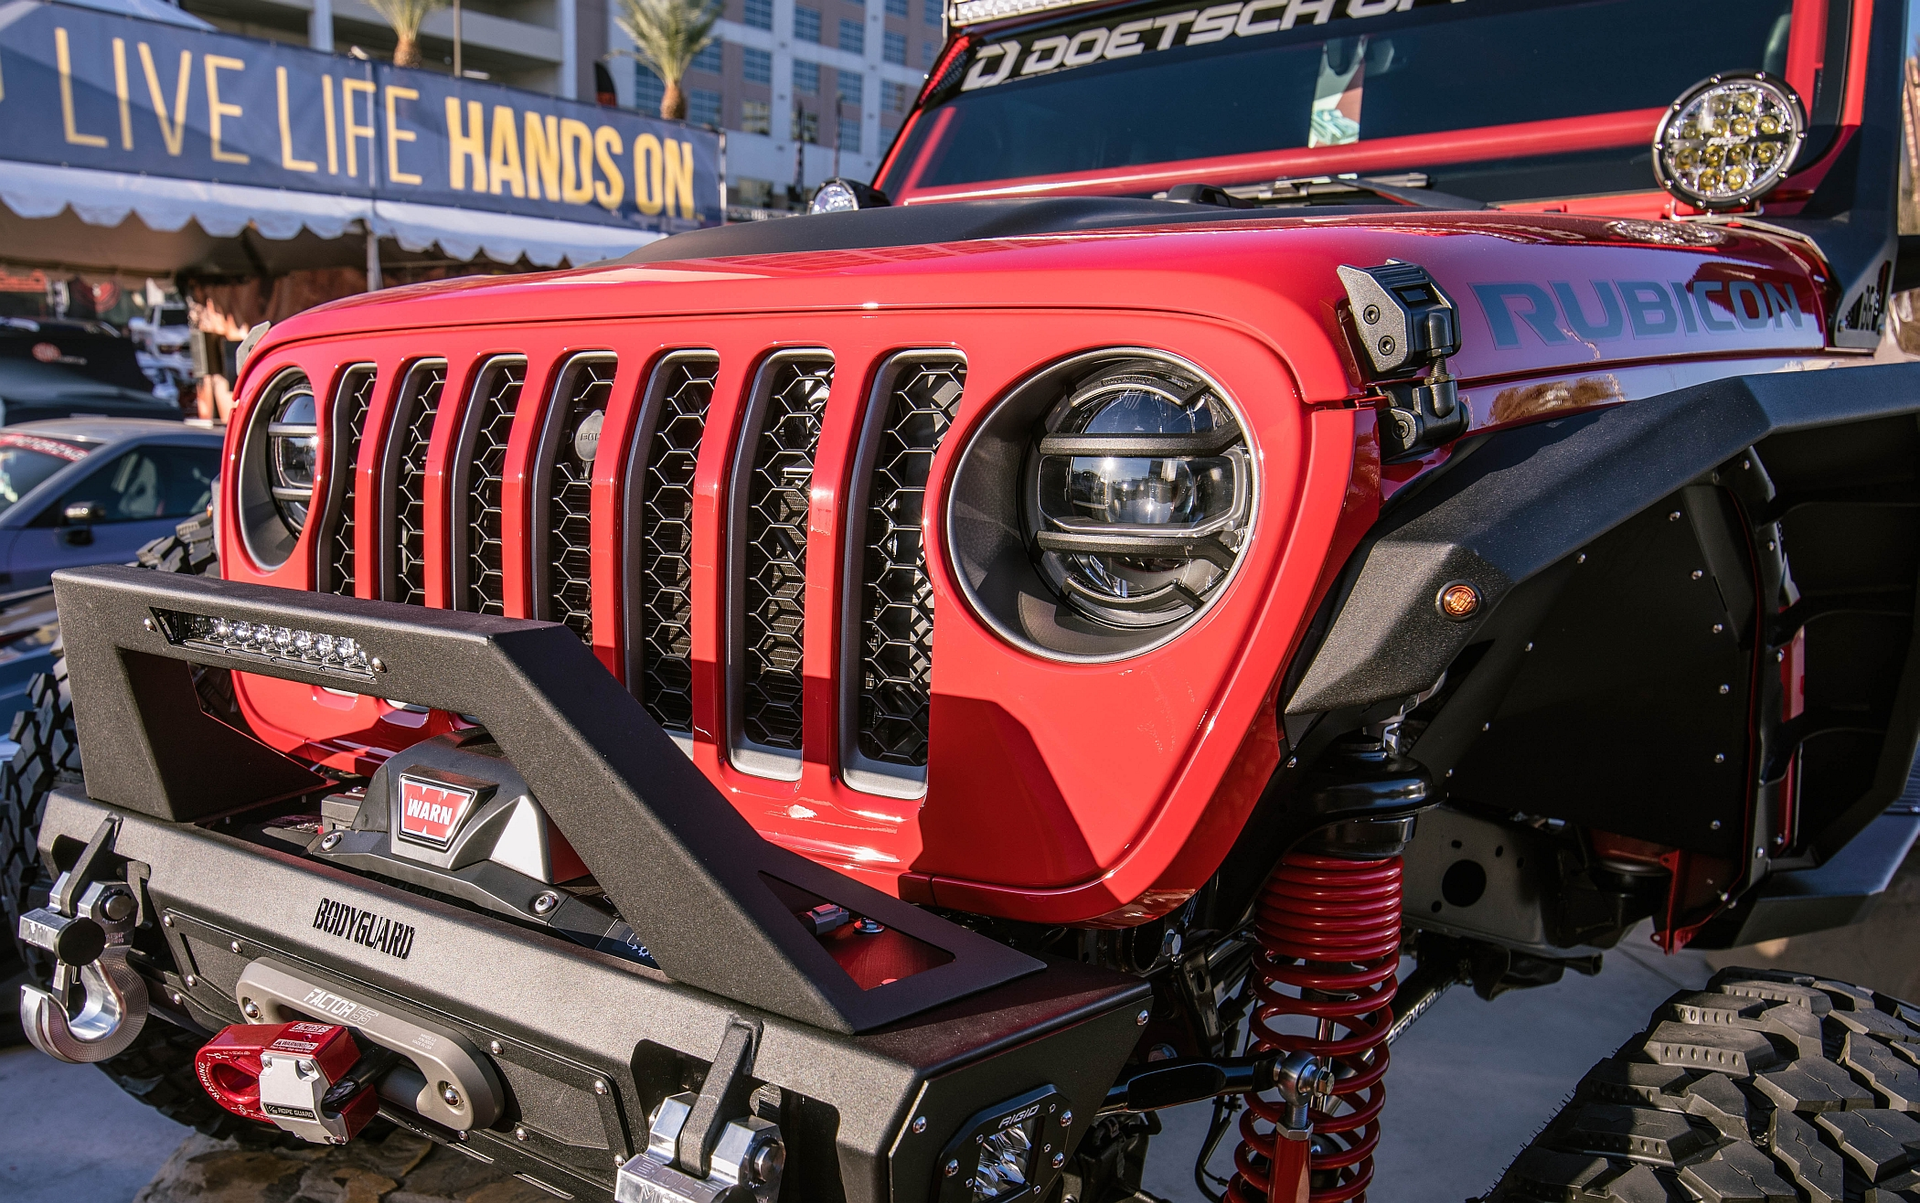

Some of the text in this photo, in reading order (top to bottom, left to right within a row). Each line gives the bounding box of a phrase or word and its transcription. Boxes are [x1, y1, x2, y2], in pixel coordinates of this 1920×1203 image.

[1020, 0, 1334, 75] DOETSCH
[54, 27, 705, 222] LIVE LIFE HANDS ON.
[1706, 134, 1750, 147] RIGID
[1467, 280, 1804, 350] RUBICON
[407, 798, 453, 826] WARN
[312, 897, 415, 960] BODYGUARD
[303, 988, 358, 1018] FACTOR
[198, 1061, 220, 1100] WARNING
[293, 1109, 314, 1118] GUARD
[998, 1104, 1040, 1129] RIGID
